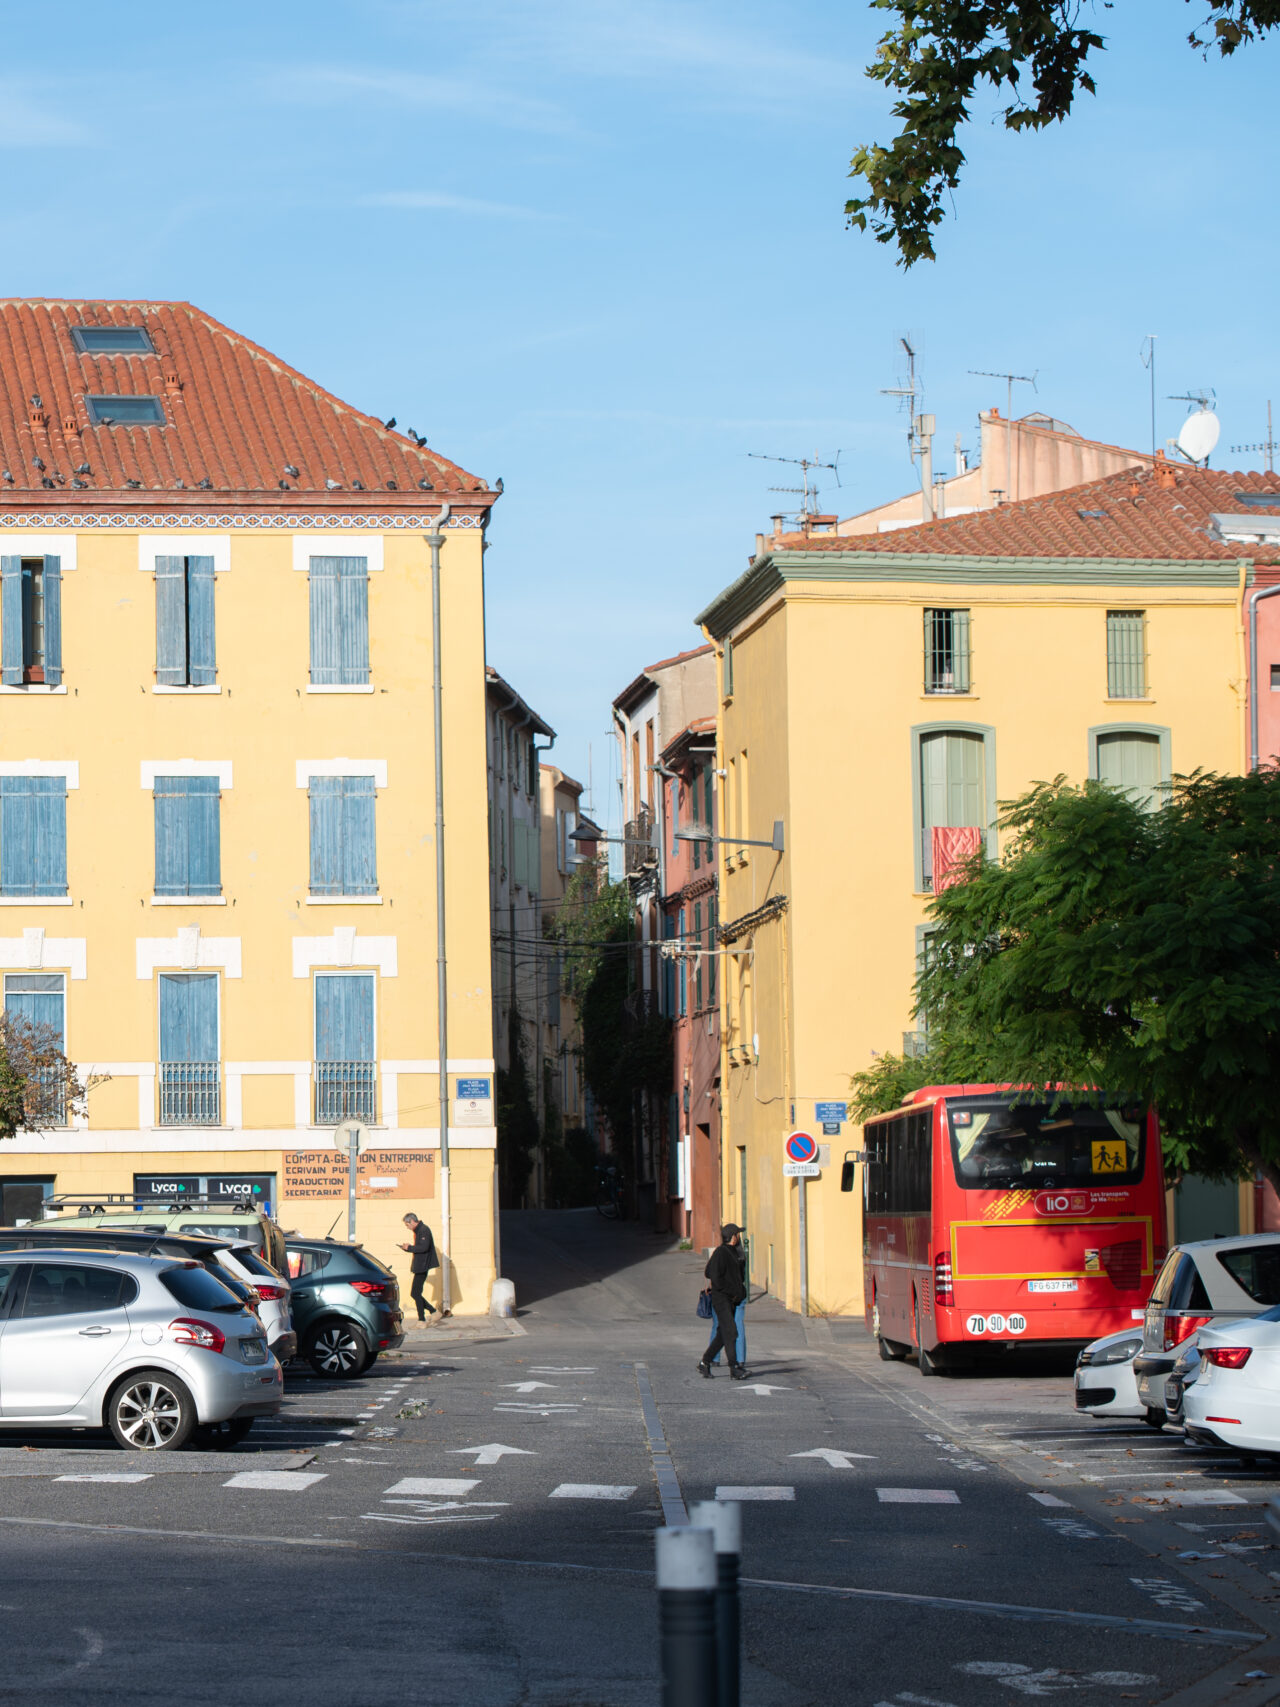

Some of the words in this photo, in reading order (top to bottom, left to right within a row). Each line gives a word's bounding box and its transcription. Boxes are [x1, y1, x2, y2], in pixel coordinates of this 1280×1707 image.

[379, 1153, 434, 1163] ENTREPRISE
[285, 1166, 327, 1174] ECRIVAIN
[332, 1166, 366, 1174] PUBIC
[151, 1182, 177, 1194] Lyca
[219, 1182, 251, 1194] Lyca
[285, 1178, 344, 1186] TRADUCTION
[285, 1189, 342, 1197] SECRETARIAT
[970, 1317, 984, 1332] 70
[990, 1316, 1002, 1331] 90
[1009, 1317, 1025, 1330] 100
